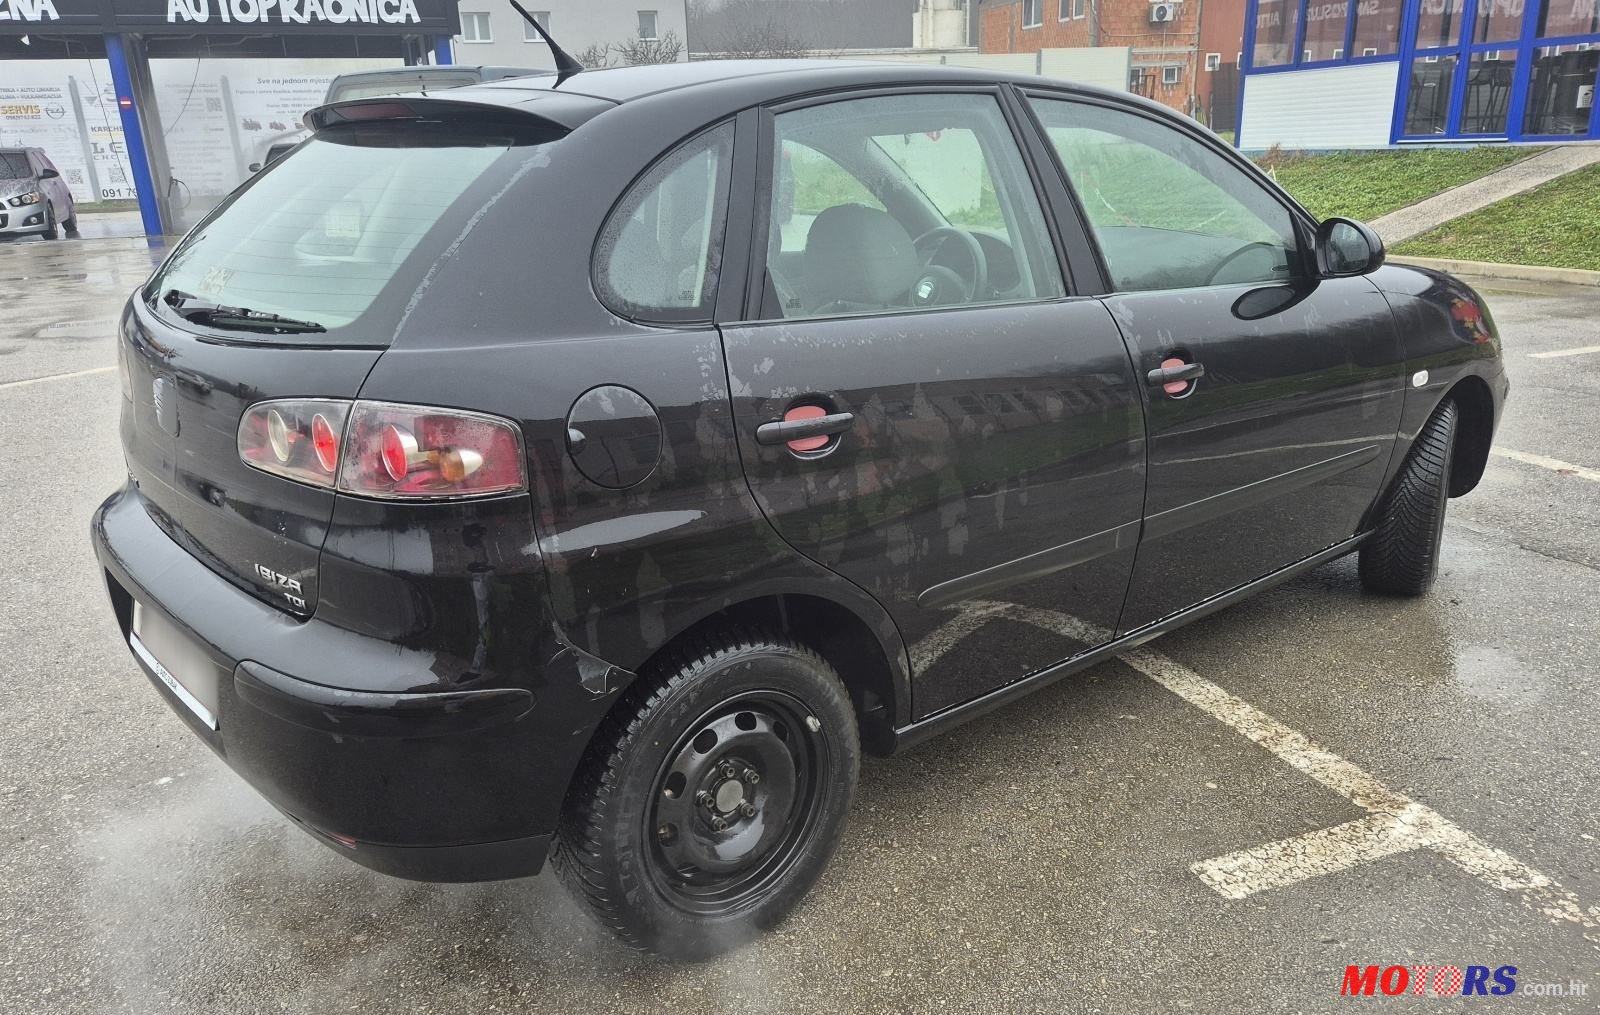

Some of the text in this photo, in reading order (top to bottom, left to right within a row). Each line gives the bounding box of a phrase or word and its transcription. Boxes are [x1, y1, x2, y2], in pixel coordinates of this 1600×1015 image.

[167, 0, 421, 24] AUTOPRAONICA
[102, 188, 122, 198] 091
[254, 563, 303, 595] IBIZA
[283, 592, 306, 609] TDI
